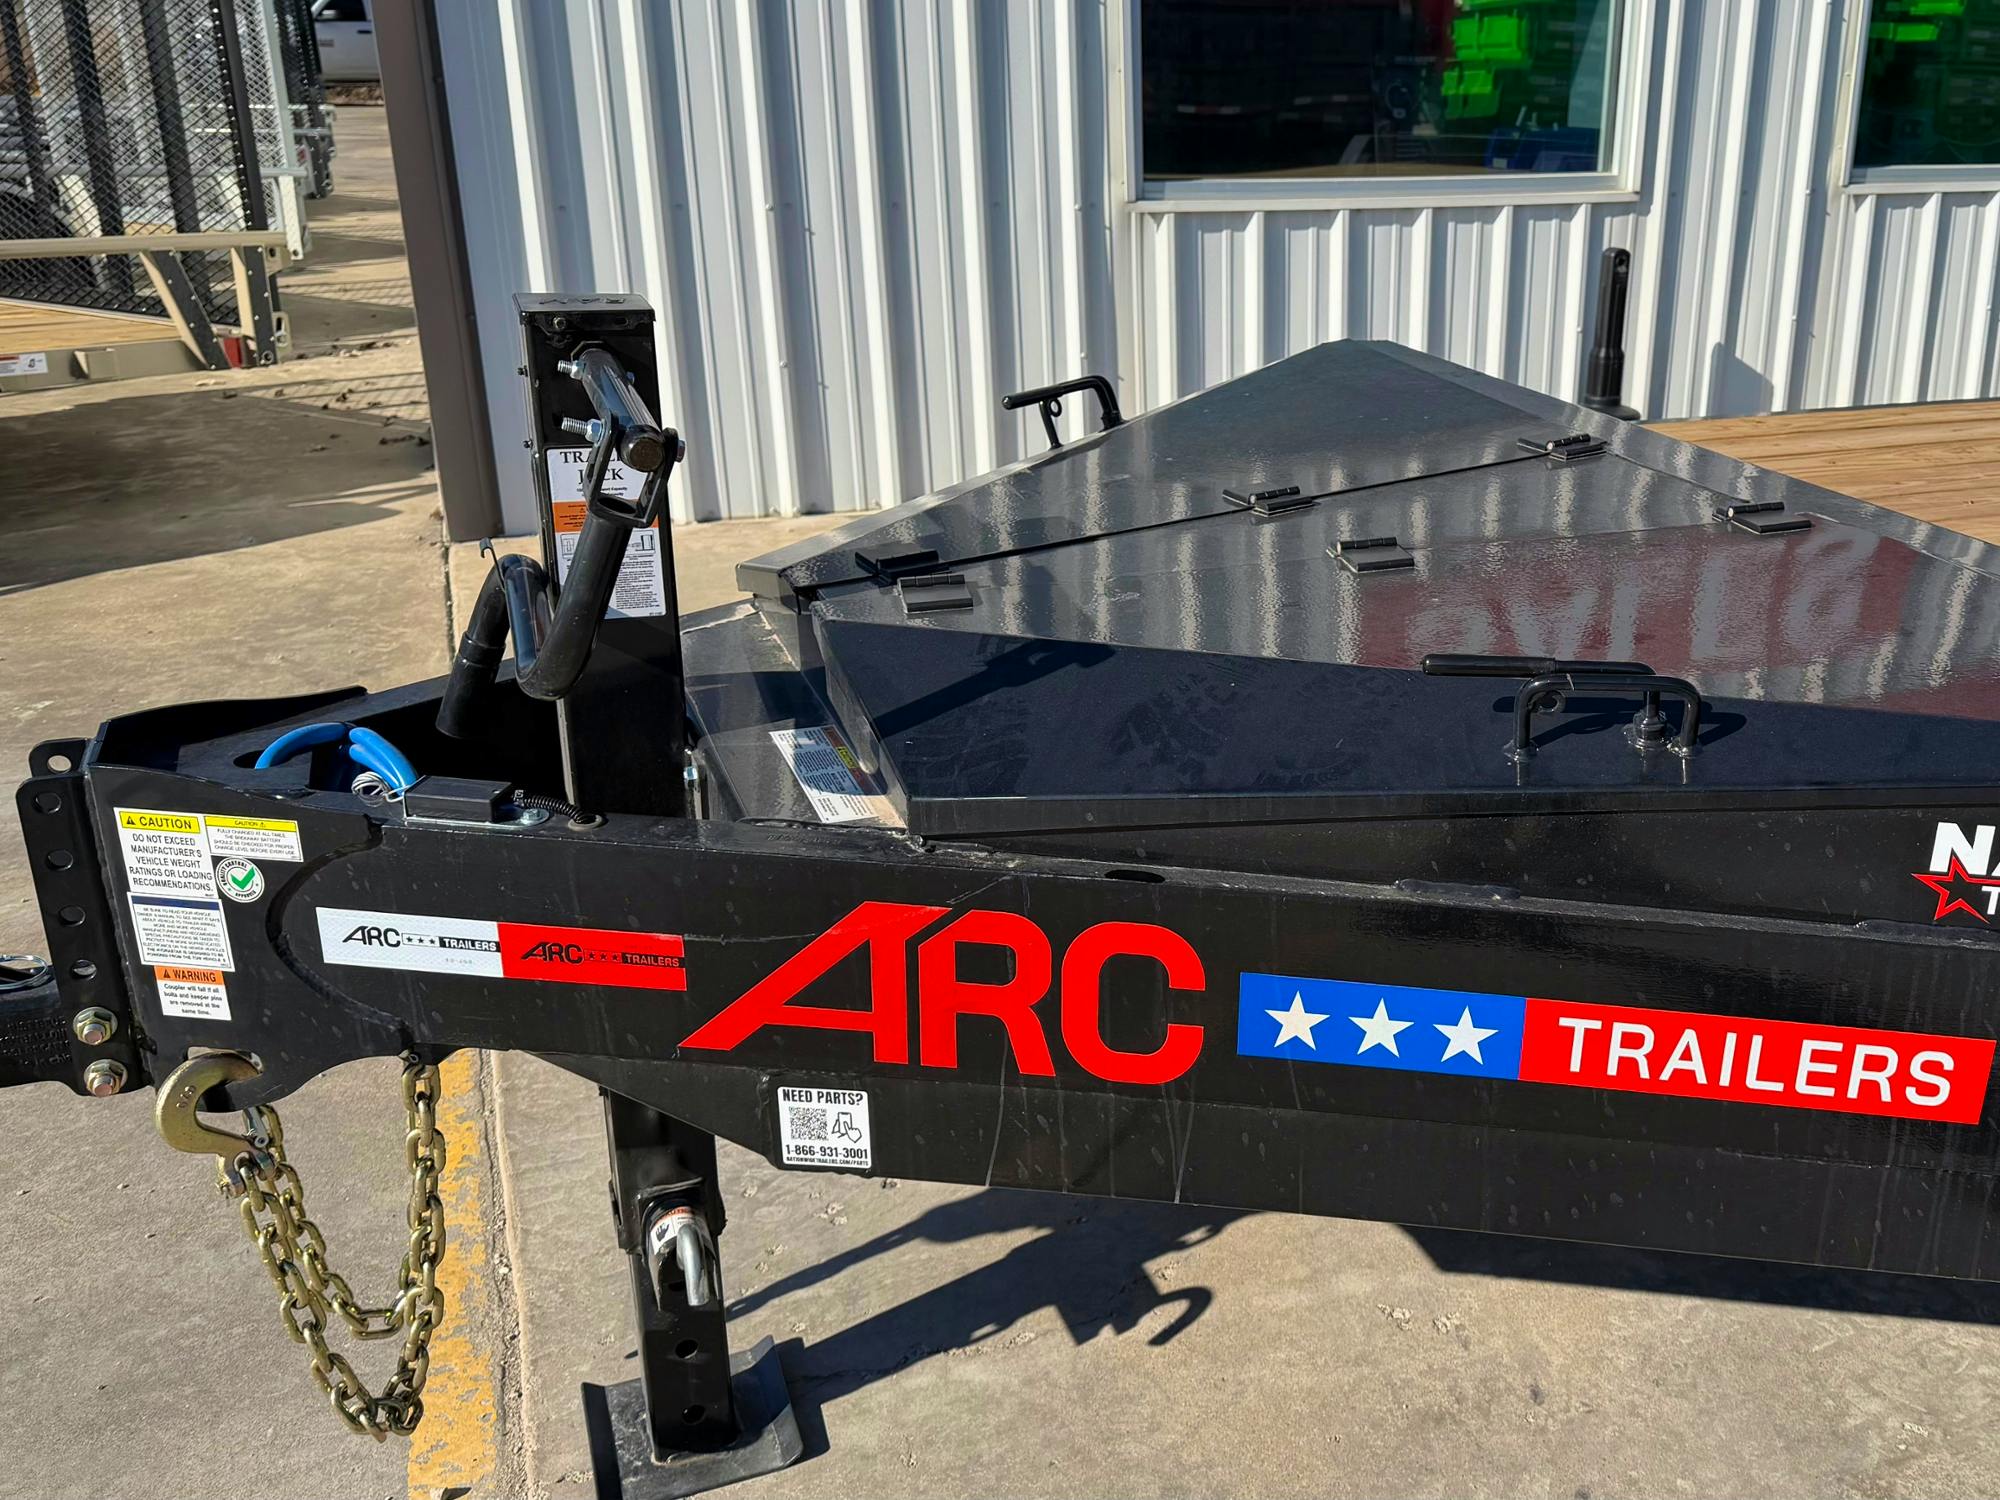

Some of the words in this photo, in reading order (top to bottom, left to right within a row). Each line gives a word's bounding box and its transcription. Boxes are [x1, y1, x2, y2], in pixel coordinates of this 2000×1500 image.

[578, 468, 624, 485] JCK
[138, 816, 191, 829] CAUTION
[132, 833, 144, 841] DO
[146, 834, 162, 843] NOT
[163, 835, 195, 846] EXCEED
[130, 844, 202, 857] MANUFACTURER'S
[135, 855, 168, 865] VEHICLE
[169, 858, 200, 868] WEIGHT
[128, 866, 162, 876] RATINGS
[163, 868, 175, 877] OR
[177, 870, 212, 880] LOADING
[132, 877, 213, 891] RECOMMENDATIONS.
[343, 926, 401, 947] ARC
[443, 940, 497, 952] TRAILERS
[521, 942, 584, 964] ARC
[626, 954, 680, 967] TRAILERS
[172, 968, 216, 982] WARNING
[678, 901, 1206, 1085] ARC
[1558, 1017, 1955, 1106] TRAILERS
[782, 1088, 812, 1103] NEED
[817, 1091, 864, 1106] PARTS?
[786, 1144, 868, 1160] 1-866-931-3001
